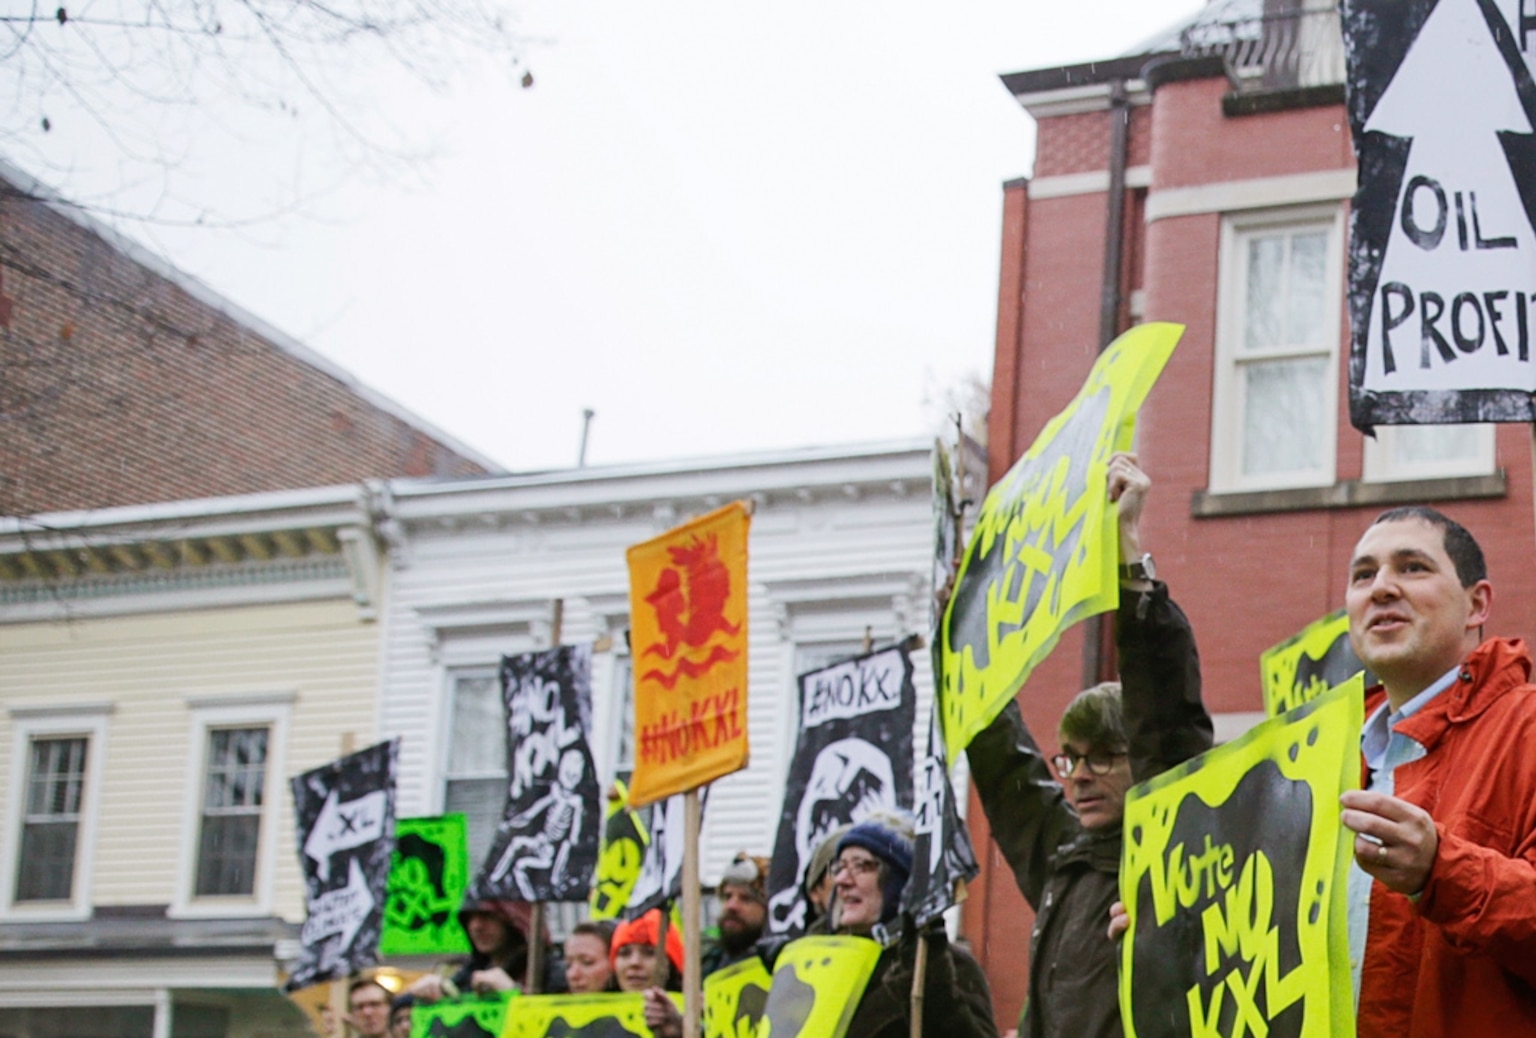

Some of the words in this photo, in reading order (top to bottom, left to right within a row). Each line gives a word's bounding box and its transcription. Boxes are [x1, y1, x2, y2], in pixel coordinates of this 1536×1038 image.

[1400, 175, 1519, 251] OIL
[1150, 834, 1235, 926] Vote
[1202, 850, 1273, 976] NO
